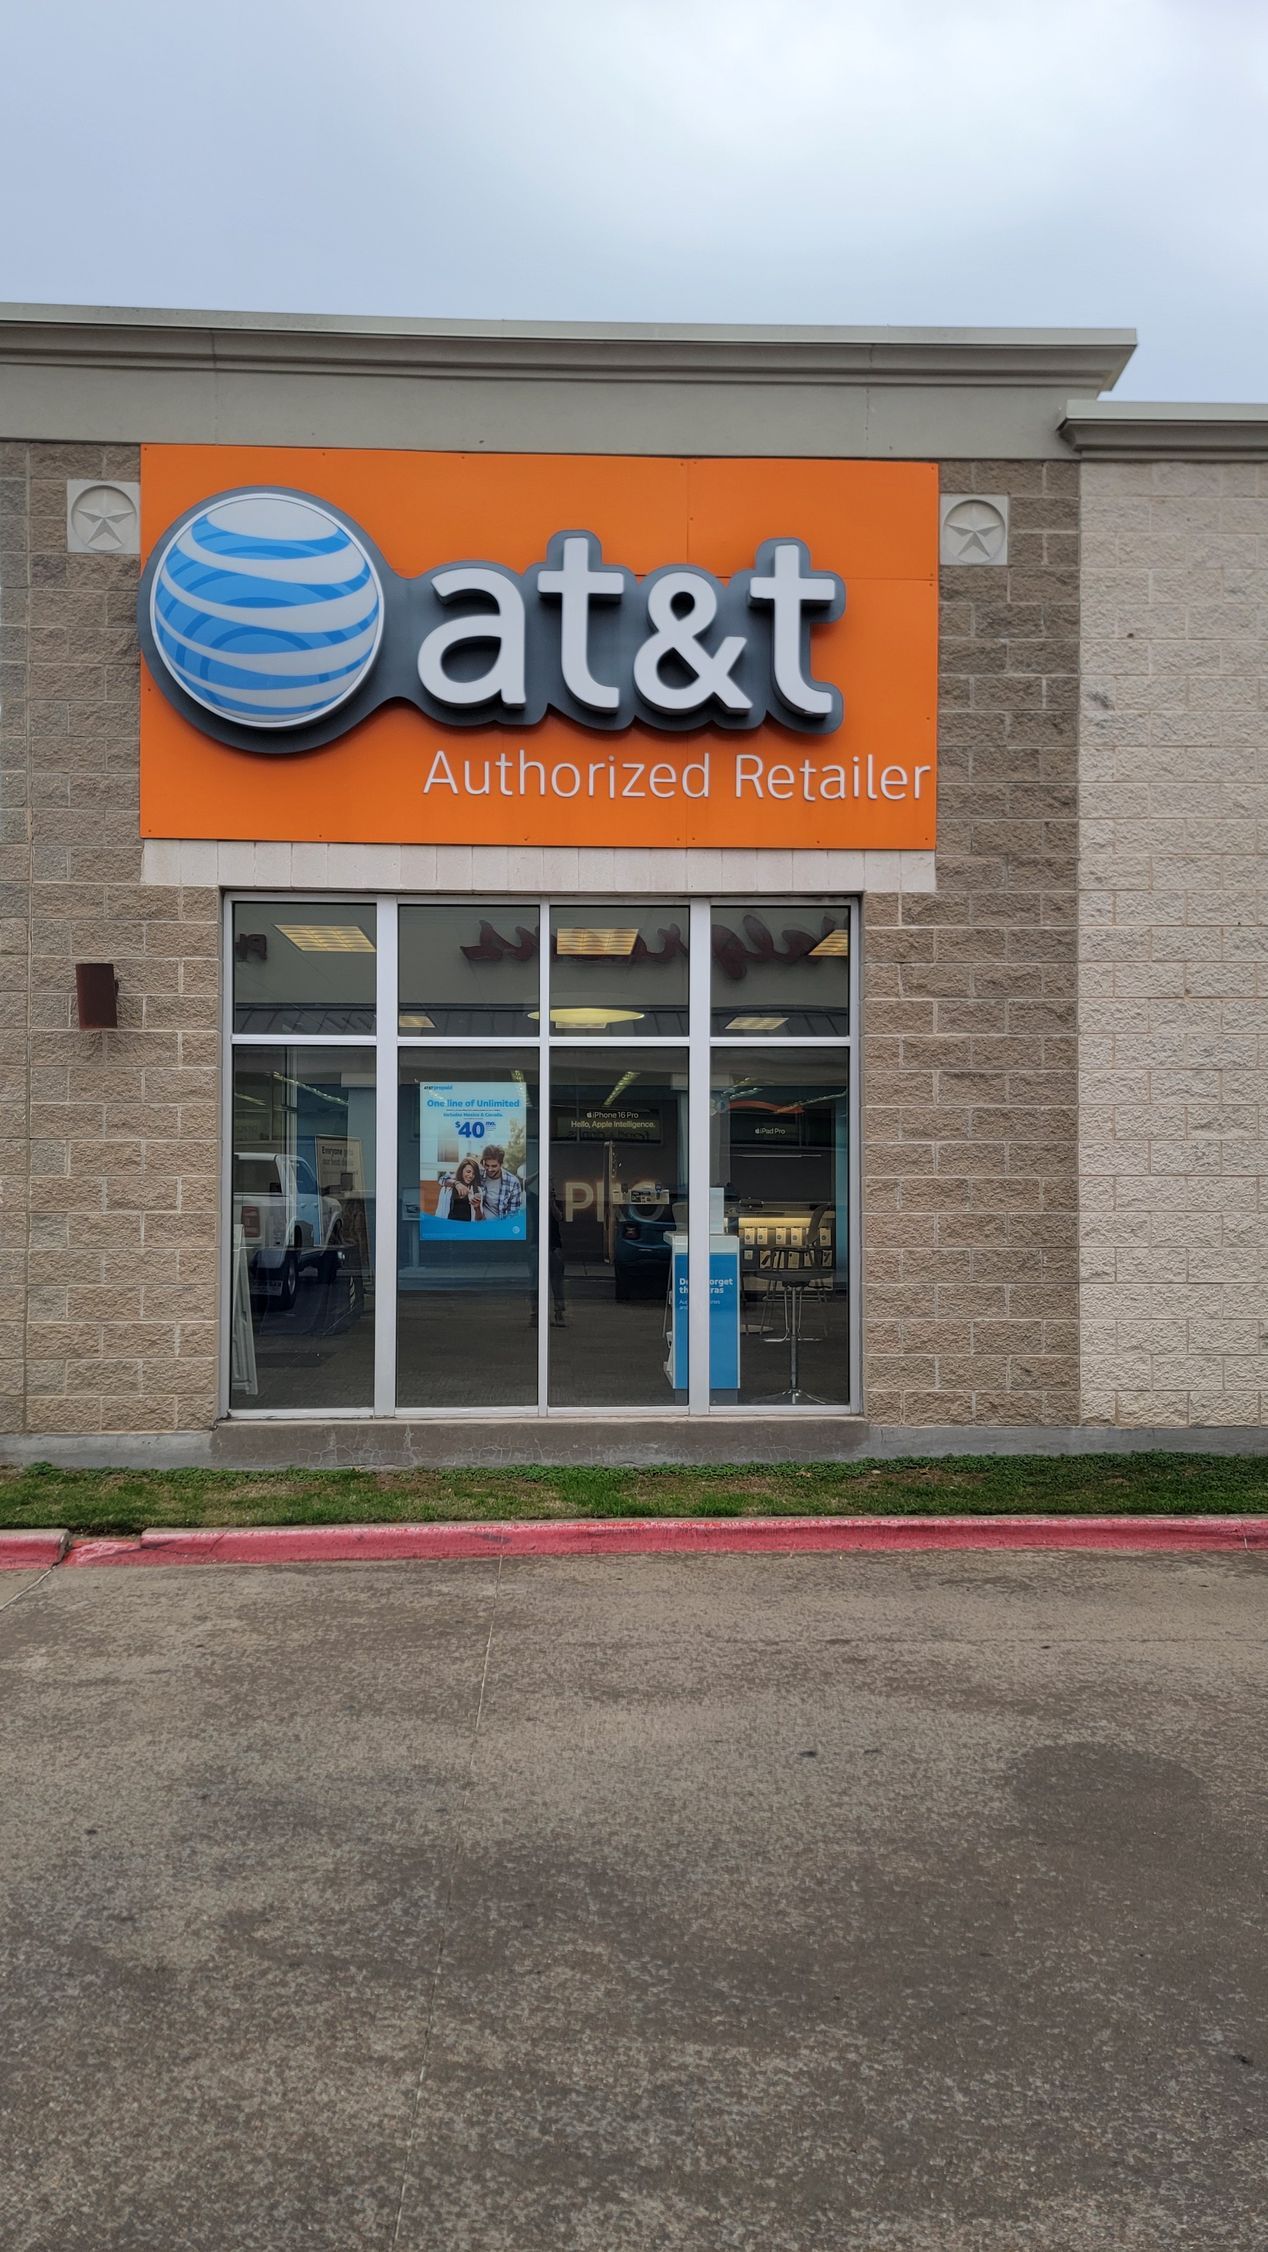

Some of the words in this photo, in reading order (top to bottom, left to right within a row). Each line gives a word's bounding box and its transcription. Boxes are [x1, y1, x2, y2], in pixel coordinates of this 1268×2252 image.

[417, 537, 836, 716] at&t
[423, 749, 710, 800] Authorized
[735, 753, 932, 802] Retailer
[427, 1099, 445, 1108] One
[447, 1099, 463, 1108] line
[465, 1099, 475, 1108] of
[477, 1099, 520, 1108] Unlimited
[592, 1111, 617, 1119] iPhone
[618, 1111, 626, 1119] 16
[627, 1111, 639, 1119] Pro
[571, 1120, 591, 1128] Hello,
[592, 1120, 613, 1129] Apple
[614, 1120, 656, 1129] Intelligence.
[759, 1127, 774, 1135] iPad
[774, 1127, 786, 1135] Pro
[709, 1278, 734, 1287] orget
